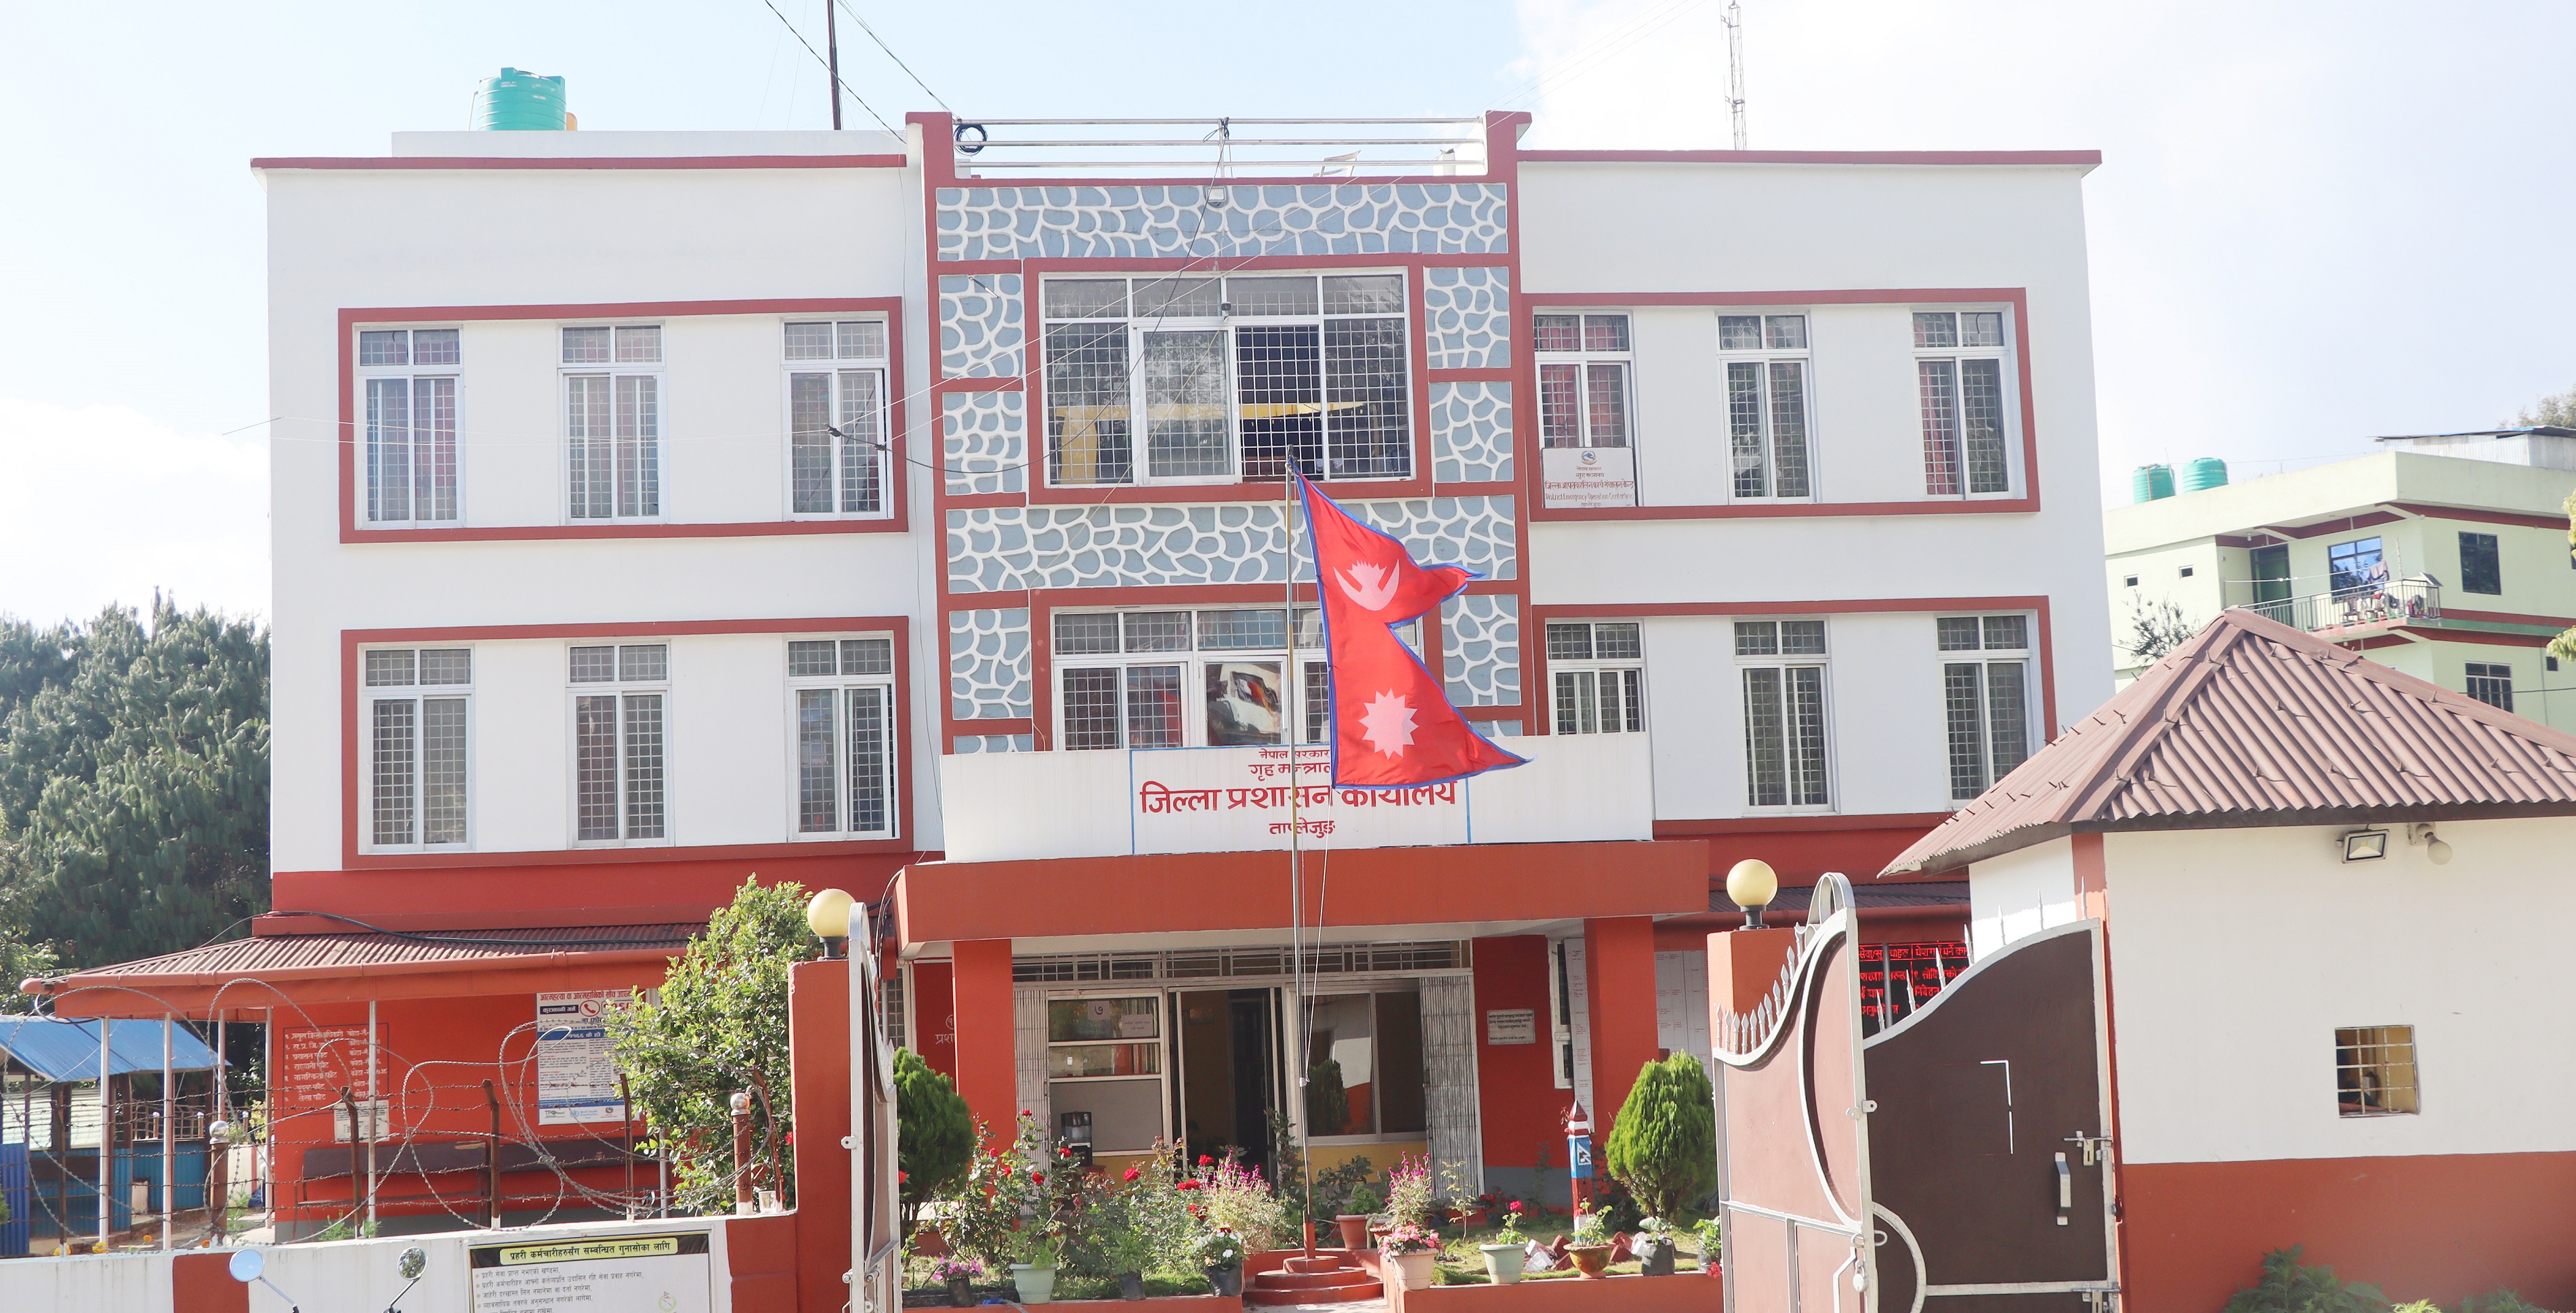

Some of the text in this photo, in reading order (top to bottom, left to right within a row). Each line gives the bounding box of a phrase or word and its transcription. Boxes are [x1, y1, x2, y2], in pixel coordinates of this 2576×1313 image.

[1544, 480, 1561, 490] जिल्ला
[1563, 493, 1587, 501] Emergency
[1587, 493, 1609, 501] Operation
[1259, 748, 1330, 759] नेपाल सरकार
[1248, 764, 1275, 781] गृह
[1139, 780, 1222, 813] जिल्ला
[1226, 785, 1333, 810] प्रशासन
[1269, 817, 1336, 838] ताप्लेजुङ
[540, 993, 566, 1001] आत्महत्या
[573, 991, 604, 999] आत्महानिको
[605, 991, 616, 999] सोच
[293, 1072, 324, 1081] नागरिकता
[509, 1249, 526, 1261] प्रहरी
[530, 1246, 580, 1259] कर्मचारीहरुसँग
[618, 1242, 650, 1255] गुनासोका
[654, 1241, 670, 1251] लागि
[482, 1270, 493, 1278] प्रहरी
[521, 1266, 539, 1276] नभएको
[524, 1276, 539, 1285] आफ्नो
[567, 1272, 586, 1282] उदासिन
[588, 1272, 596, 1280] रहि
[625, 1270, 643, 1279] नगरेमा,
[482, 1289, 497, 1299] जाहेरी
[499, 1288, 518, 1297] दरखास्त
[520, 1287, 530, 1296] लिन
[532, 1287, 552, 1295] नमानेमा
[574, 1284, 592, 1293] नगरेमा,
[513, 1297, 528, 1306] तवरले
[556, 1296, 573, 1304] नगरेको
